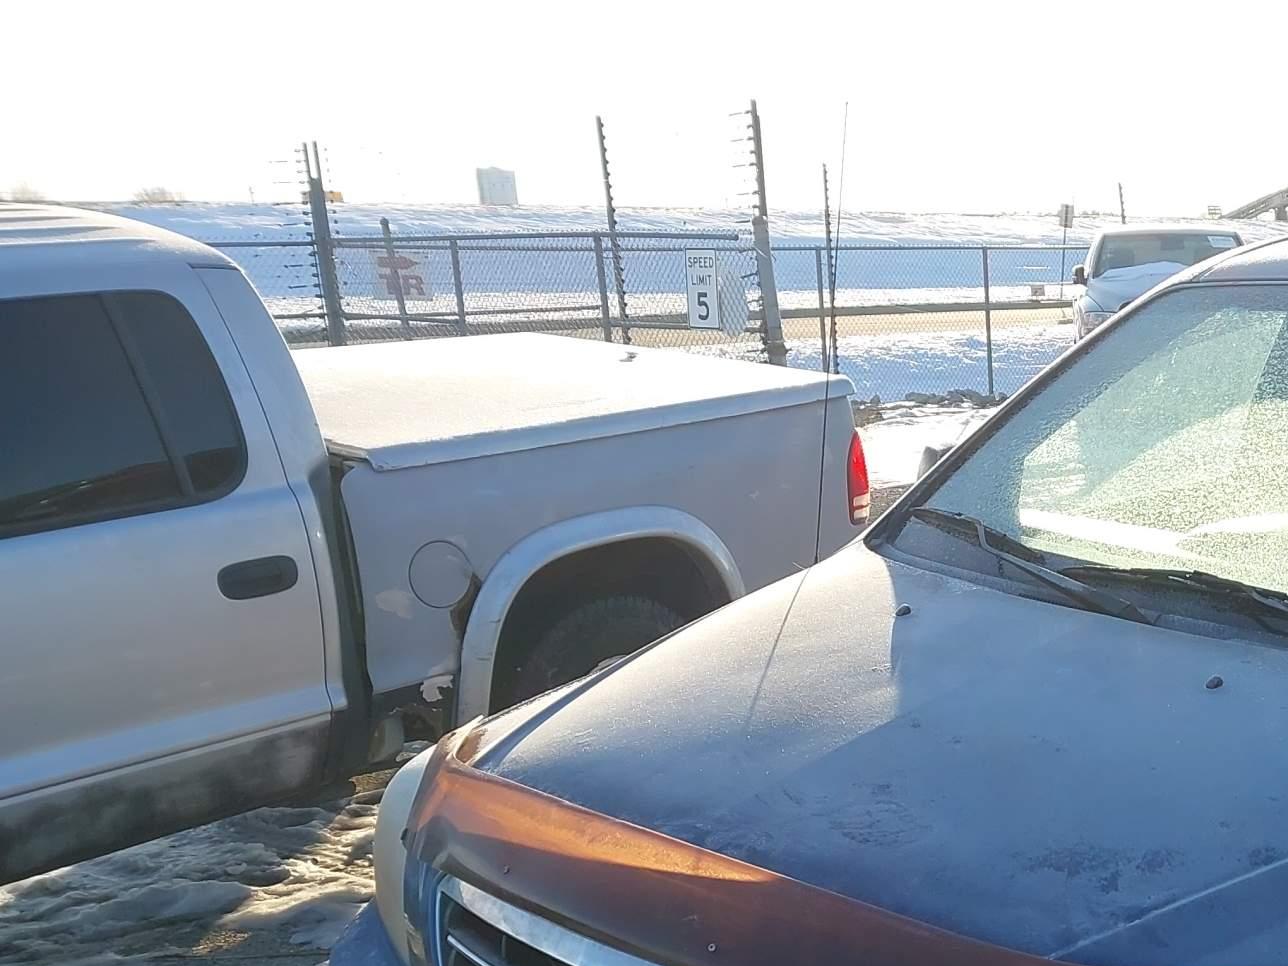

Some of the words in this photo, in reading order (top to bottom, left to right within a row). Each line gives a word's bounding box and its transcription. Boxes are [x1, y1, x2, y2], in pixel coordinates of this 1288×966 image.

[688, 256, 714, 268] SPEED
[691, 274, 712, 286] LIMIT
[697, 291, 710, 321] 5
